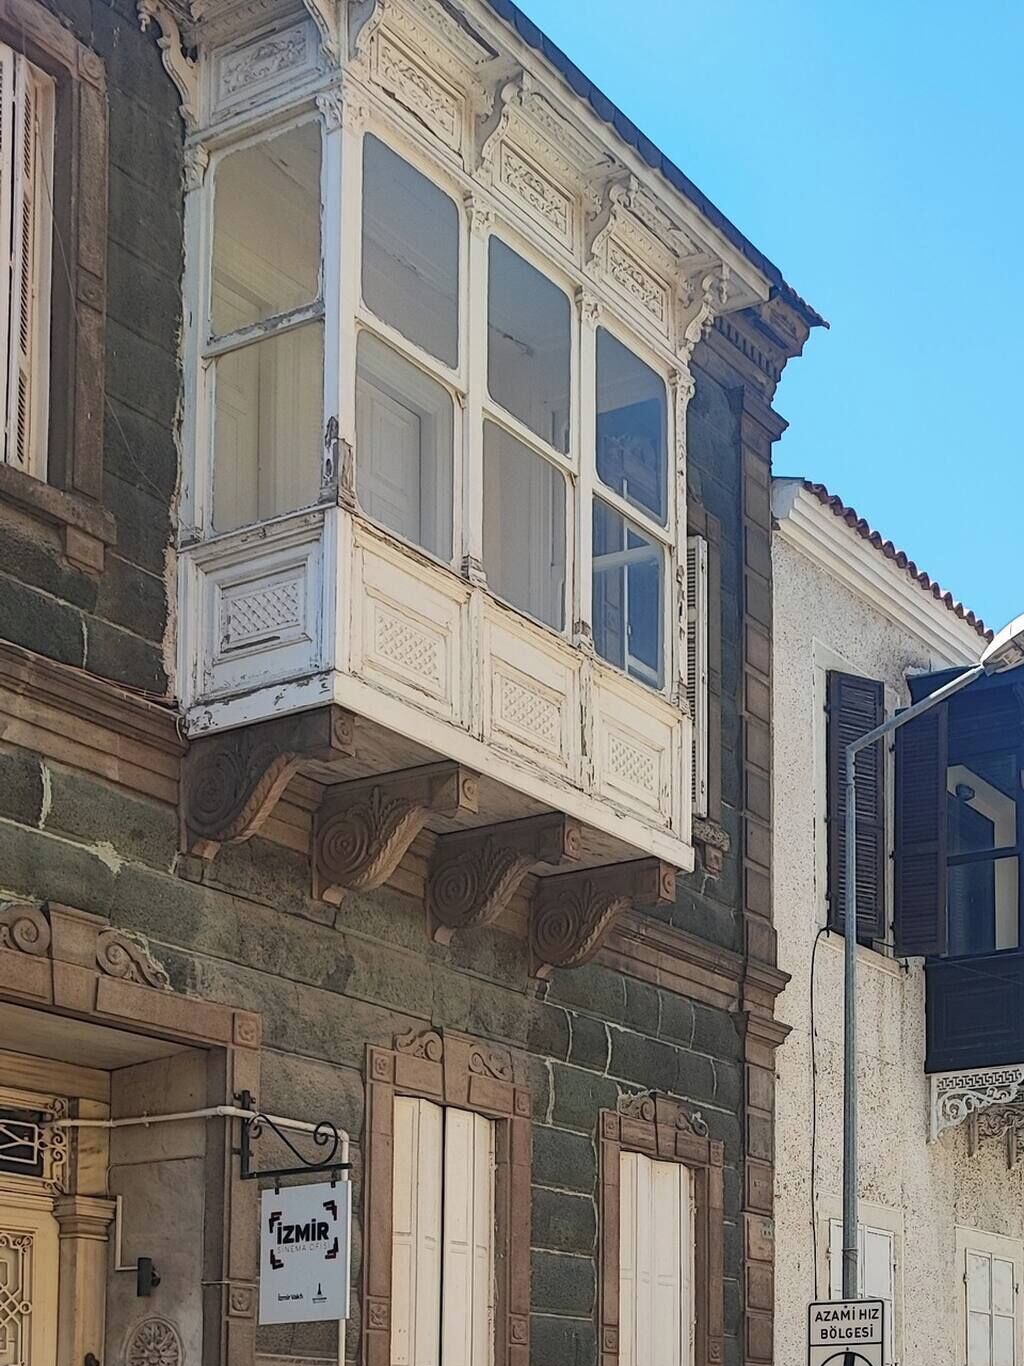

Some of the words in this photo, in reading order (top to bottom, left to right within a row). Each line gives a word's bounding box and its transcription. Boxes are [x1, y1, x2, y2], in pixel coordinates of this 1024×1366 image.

[277, 1219, 329, 1245] İZMİR
[815, 1307, 856, 1322] AZAMİ
[859, 1308, 880, 1320] HIZ
[820, 1324, 873, 1339] BÖLGESİ
